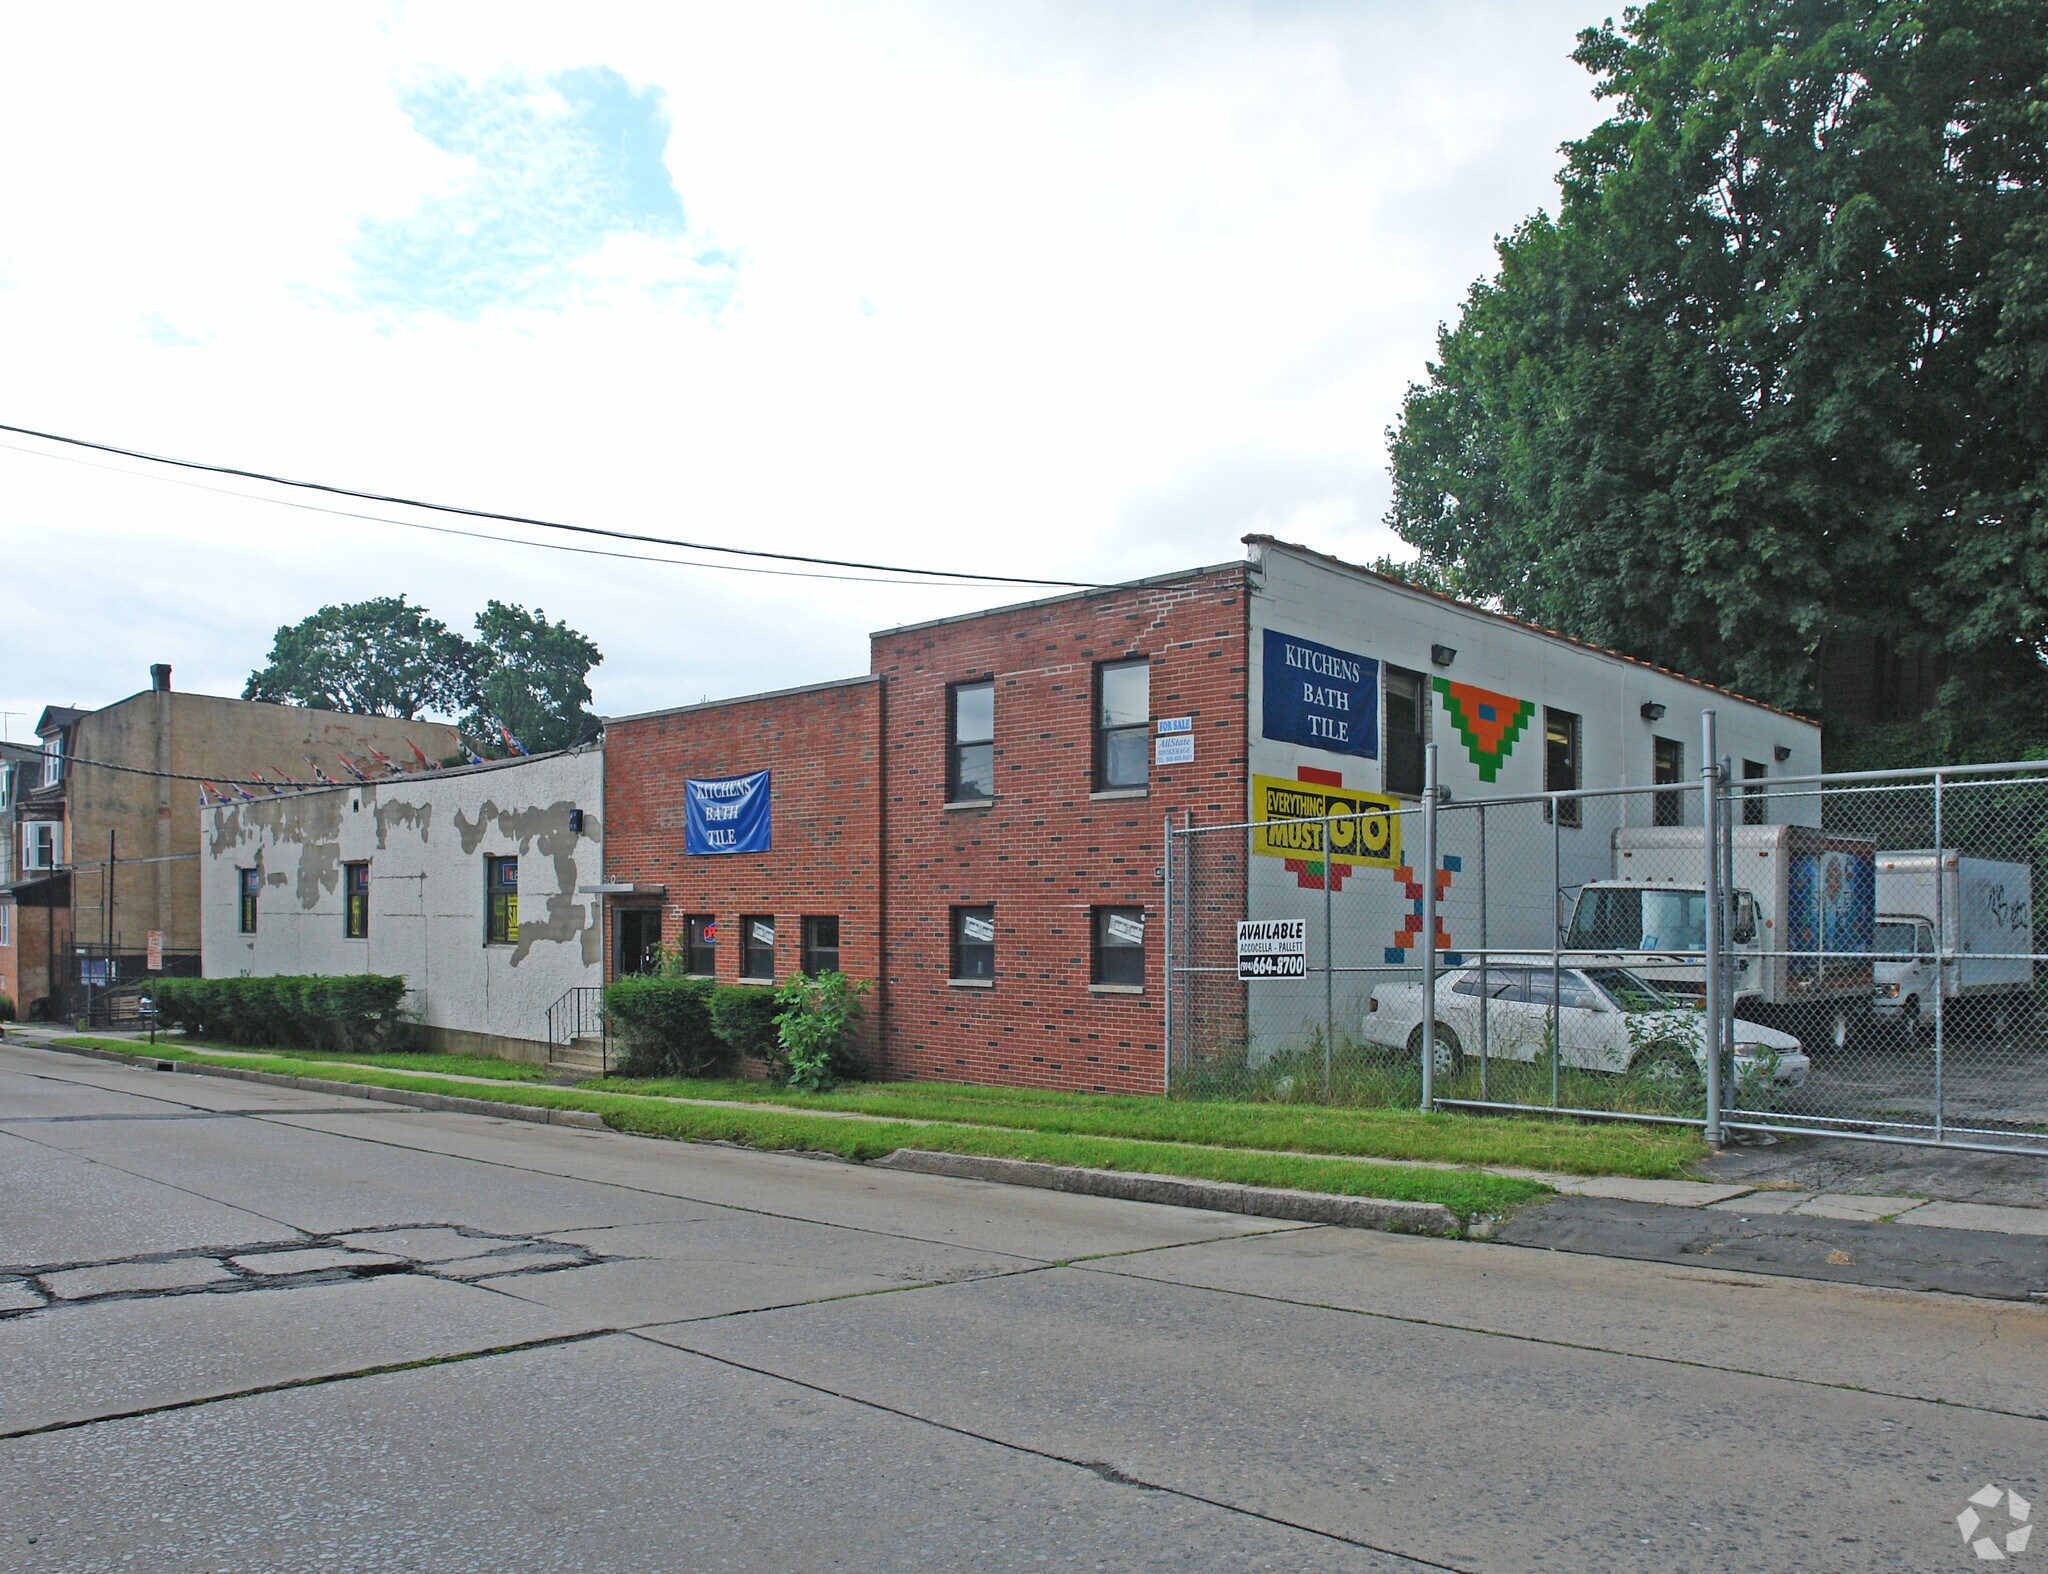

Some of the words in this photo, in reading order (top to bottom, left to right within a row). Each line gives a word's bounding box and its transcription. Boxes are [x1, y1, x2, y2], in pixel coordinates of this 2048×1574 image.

[1285, 643, 1360, 683] KITCHENS
[1303, 682, 1349, 711] BATH
[1159, 720, 1172, 731] FOR
[1173, 718, 1190, 730] SALE
[1307, 714, 1349, 742] TILE
[696, 779, 751, 799] KITCHENS
[706, 804, 739, 821] BATH
[1267, 790, 1323, 816] EVERYTHING
[1268, 818, 1322, 850] MUST
[1328, 801, 1388, 851] GO
[707, 829, 736, 845] TILE
[1240, 922, 1304, 940] AVAILABLE
[1279, 942, 1303, 952] PALLETT
